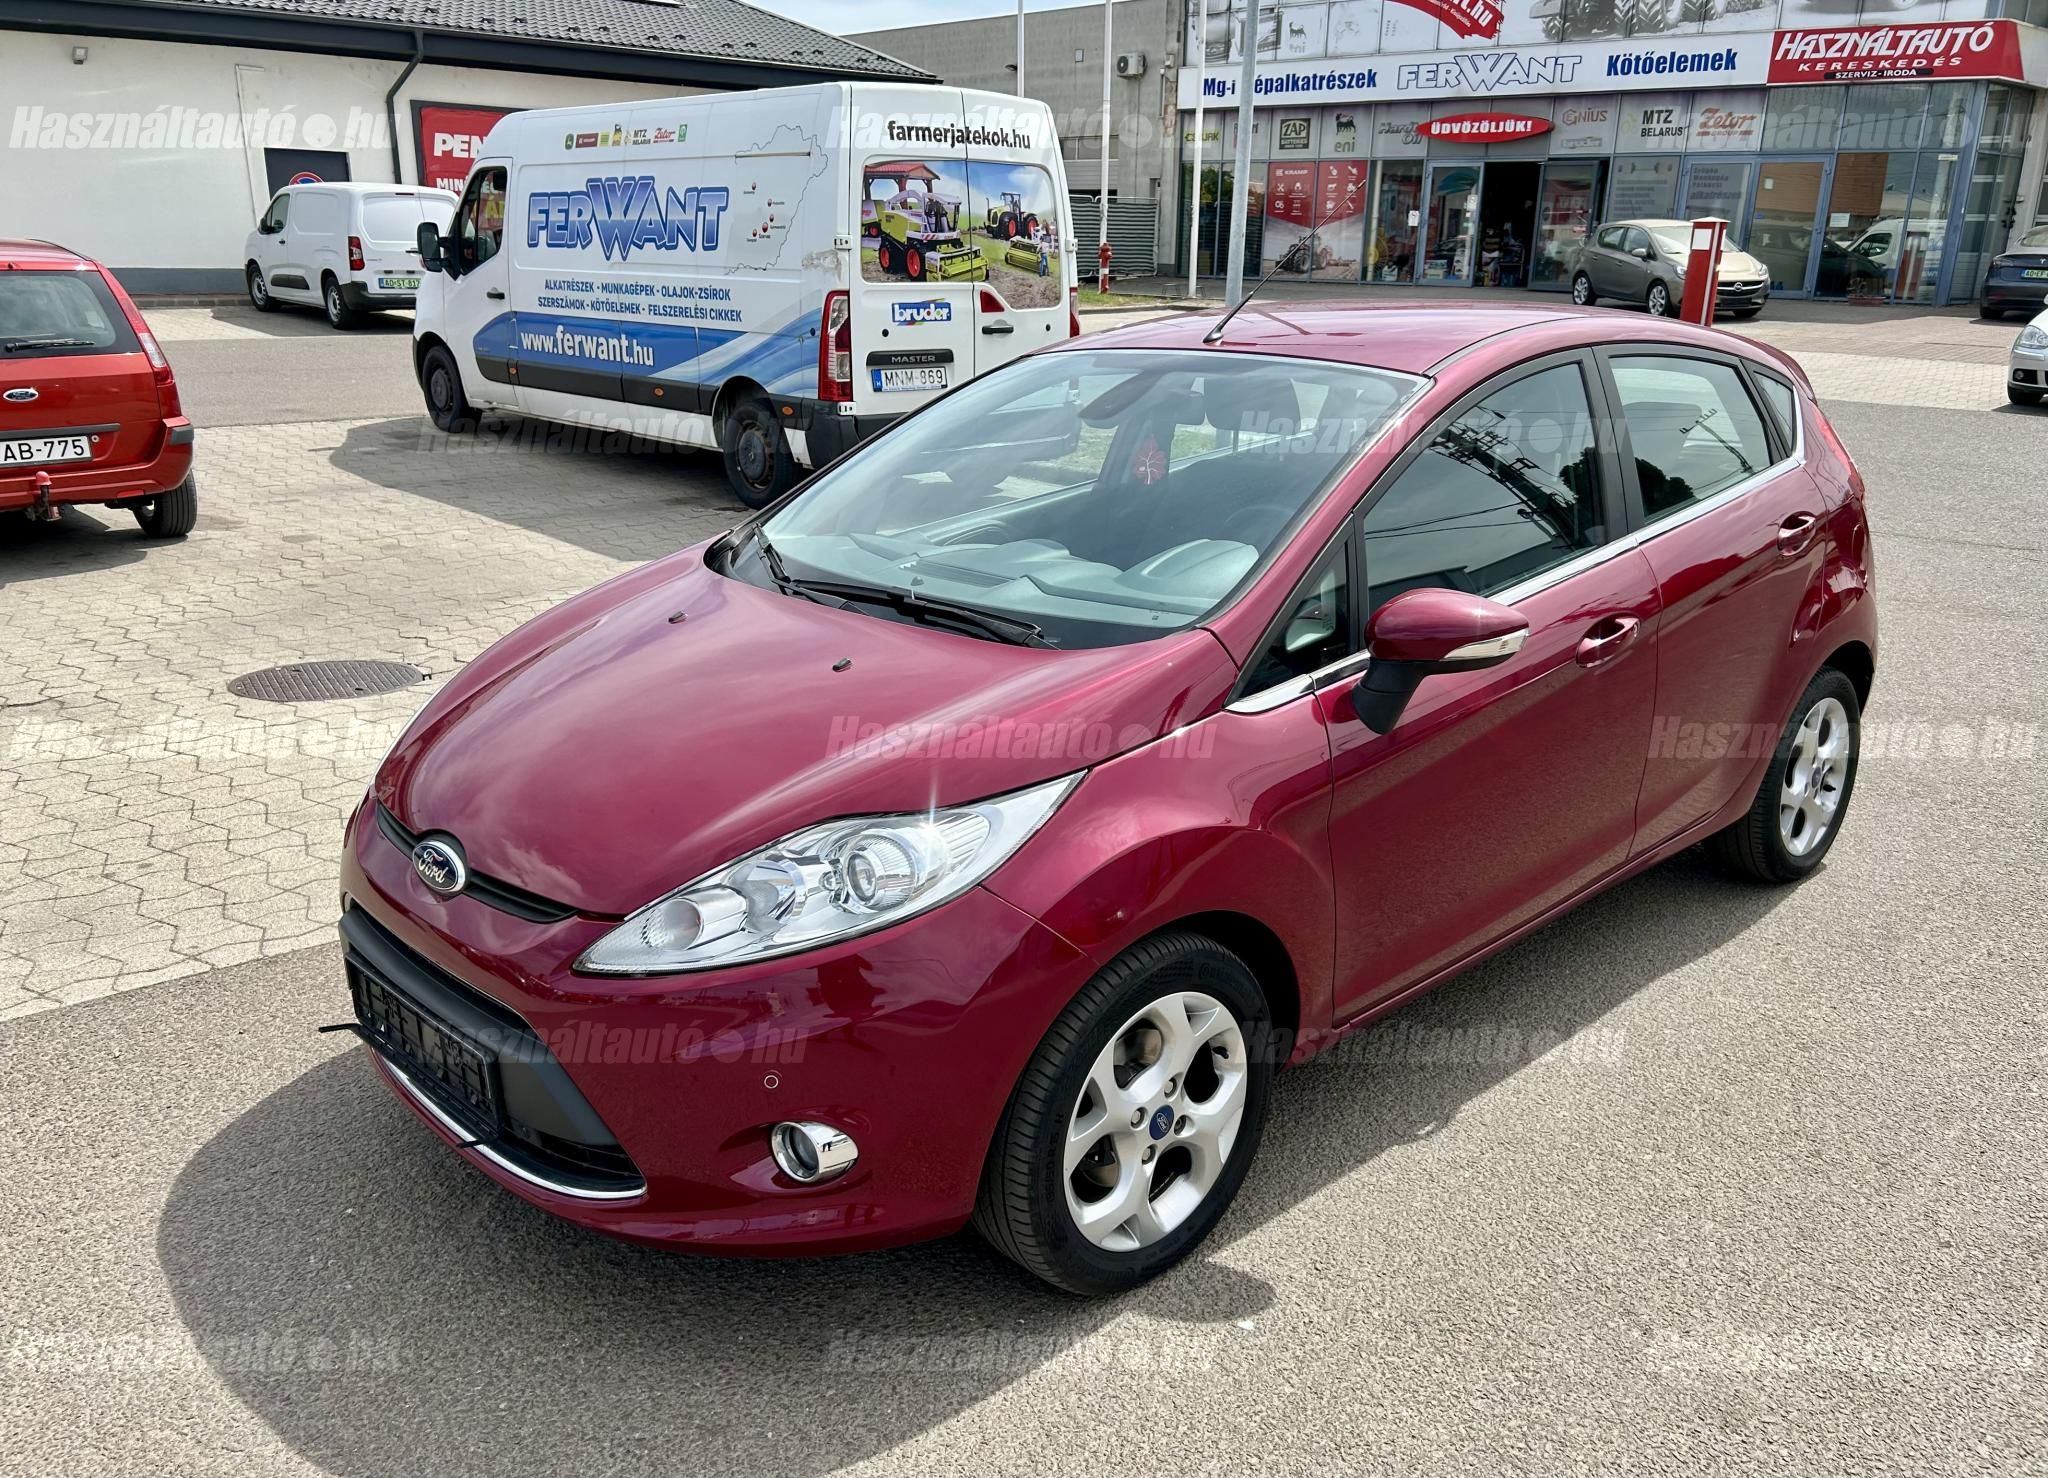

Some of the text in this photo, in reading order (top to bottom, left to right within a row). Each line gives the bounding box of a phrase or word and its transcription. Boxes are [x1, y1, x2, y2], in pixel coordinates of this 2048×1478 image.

[1775, 22, 1994, 60] HASZNÁLTAUTÓ
[1607, 48, 1738, 77] Kötőelemek
[1798, 56, 1963, 72] KERESKEDÉS
[1397, 53, 1582, 91] FERWANT
[1254, 68, 1377, 96] épalkatrészek
[1642, 109, 1674, 125] MTZ
[887, 120, 1031, 150] farmerjatekok.hu
[1283, 122, 1306, 137] ZAP
[1431, 118, 1532, 135] ÜDVÖZÖLJÜK!
[1641, 127, 1683, 138] BELARUS
[1334, 137, 1356, 152] eni
[527, 176, 729, 261] FERWANT
[544, 279, 594, 293] ALKATRÉSZEK
[601, 281, 655, 297] MUNKAGÉPEK
[538, 295, 586, 311] SZERSZÁMOK
[648, 303, 743, 323] FELSZERELÉSI CIKKEK
[894, 304, 949, 321] bruder
[520, 326, 654, 366] www.ferwant.hu
[892, 355, 936, 364] MASTER
[884, 369, 943, 387] MNM-869
[4, 439, 85, 462] AB-775
[417, 848, 448, 883] Ford
